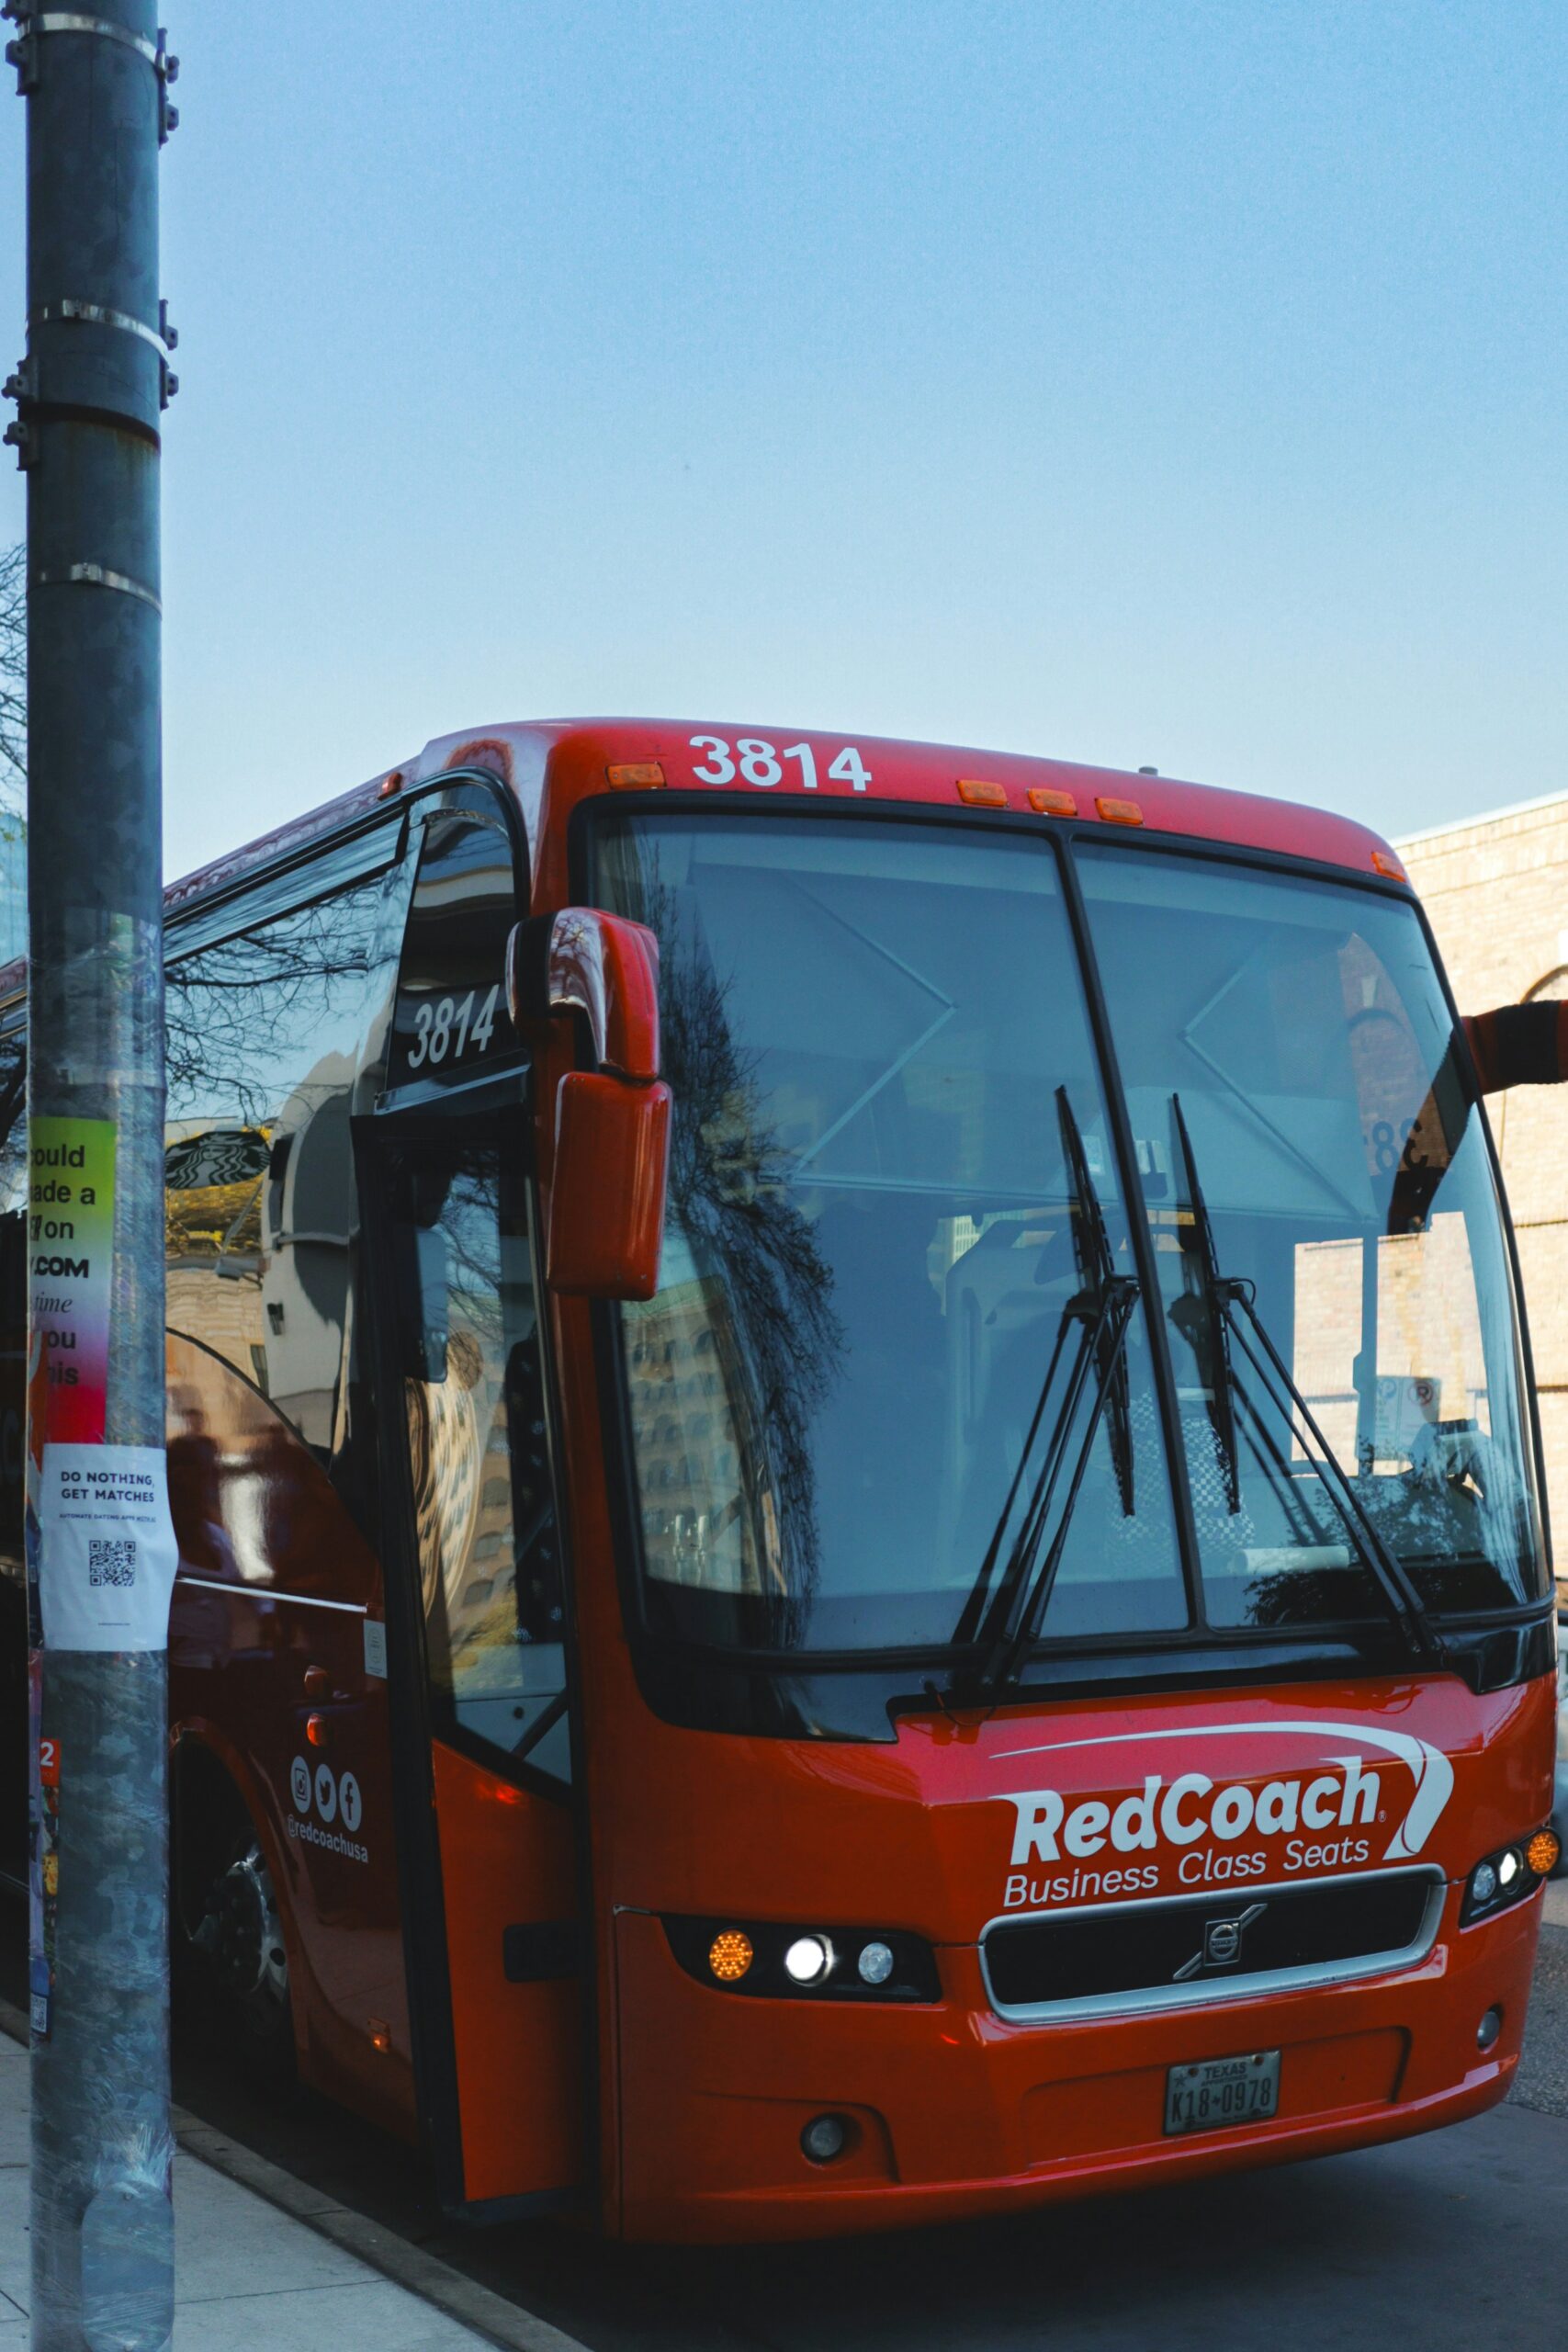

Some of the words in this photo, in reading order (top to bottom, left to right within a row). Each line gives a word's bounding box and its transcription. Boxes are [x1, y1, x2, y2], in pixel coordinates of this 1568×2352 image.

[690, 735, 872, 791] 3814
[408, 984, 500, 1069] 3814
[79, 1187, 96, 1205] a
[45, 1220, 73, 1239] on
[34, 1291, 73, 1313] time
[47, 1329, 75, 1350] ou
[61, 1471, 81, 1482] DO
[61, 1488, 89, 1499] GET
[95, 1489, 154, 1503] MATCHES
[988, 1756, 1381, 1865] RedCoach
[288, 1814, 369, 1864] @redcoachusa
[1003, 1863, 1159, 1907] Business
[1179, 1849, 1267, 1883] Class
[1282, 1837, 1369, 1871] Seats
[1204, 2062, 1247, 2079] TEXAS
